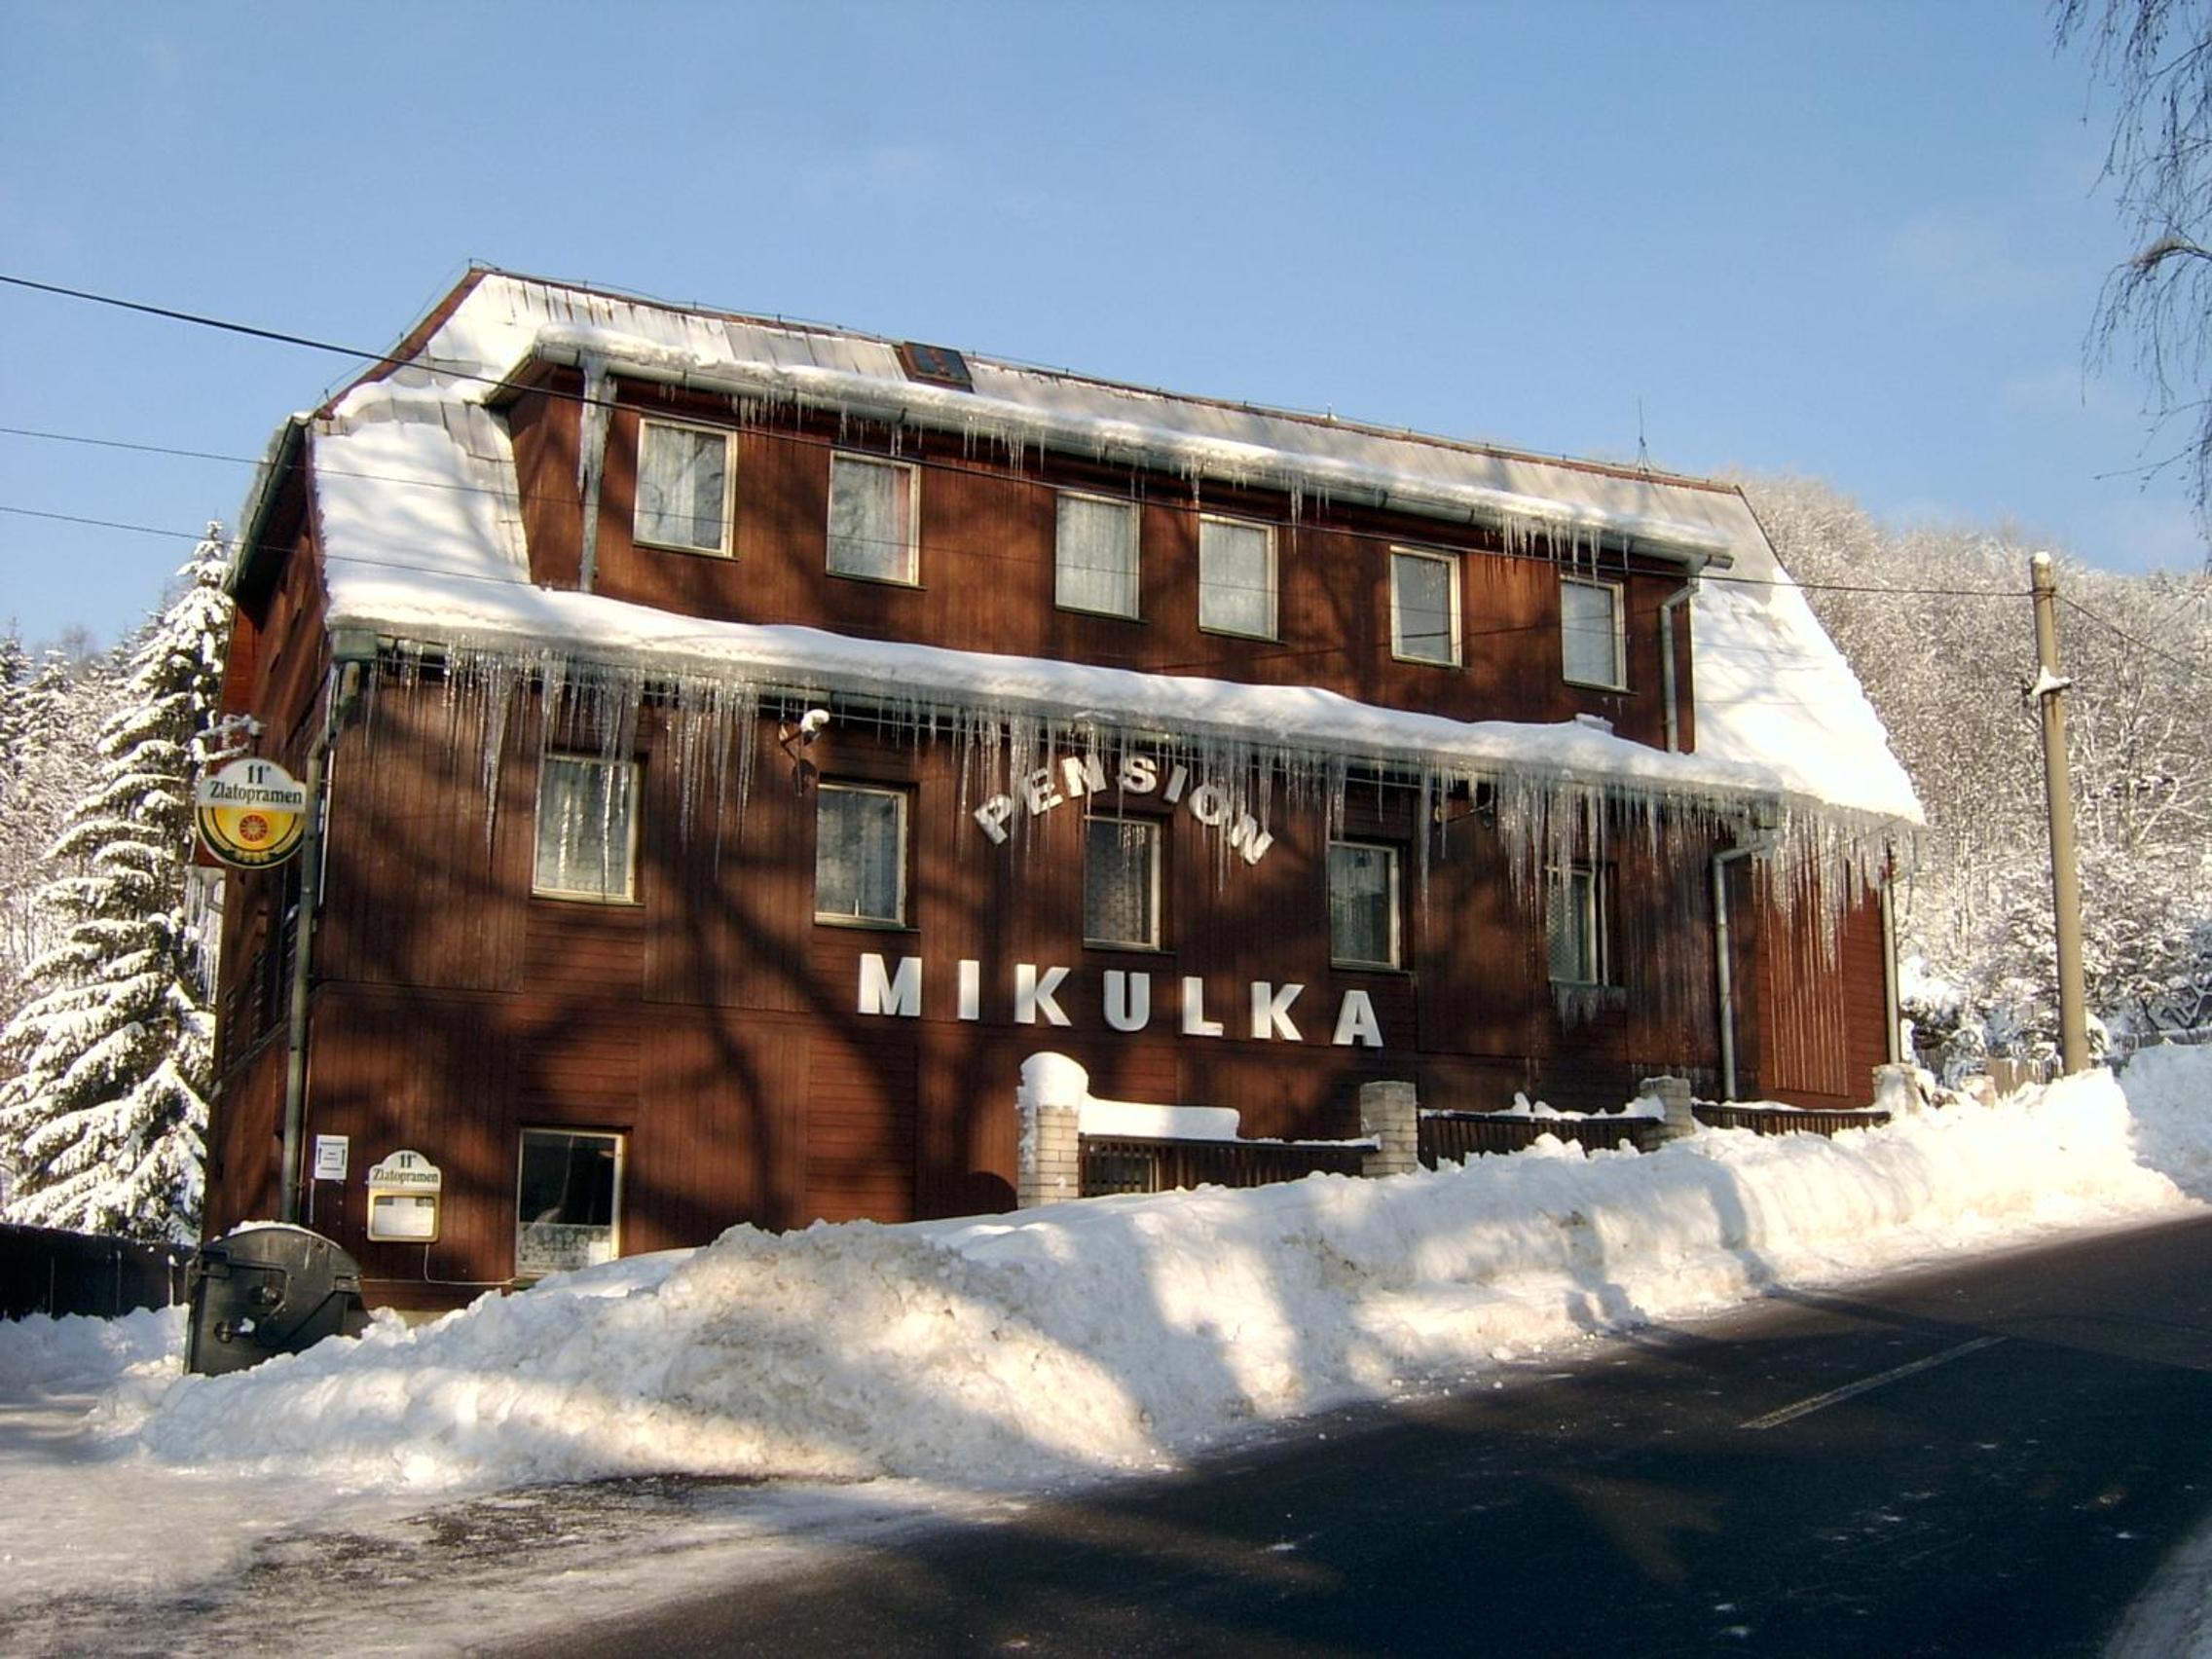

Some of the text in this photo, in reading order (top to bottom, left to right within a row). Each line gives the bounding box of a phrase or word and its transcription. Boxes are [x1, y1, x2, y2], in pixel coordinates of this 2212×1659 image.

[209, 781, 303, 805] Zlatopramen
[974, 753, 1274, 866] PENSION
[857, 952, 1384, 1048] MIKULKA
[373, 1168, 438, 1184] Zlatopramen
